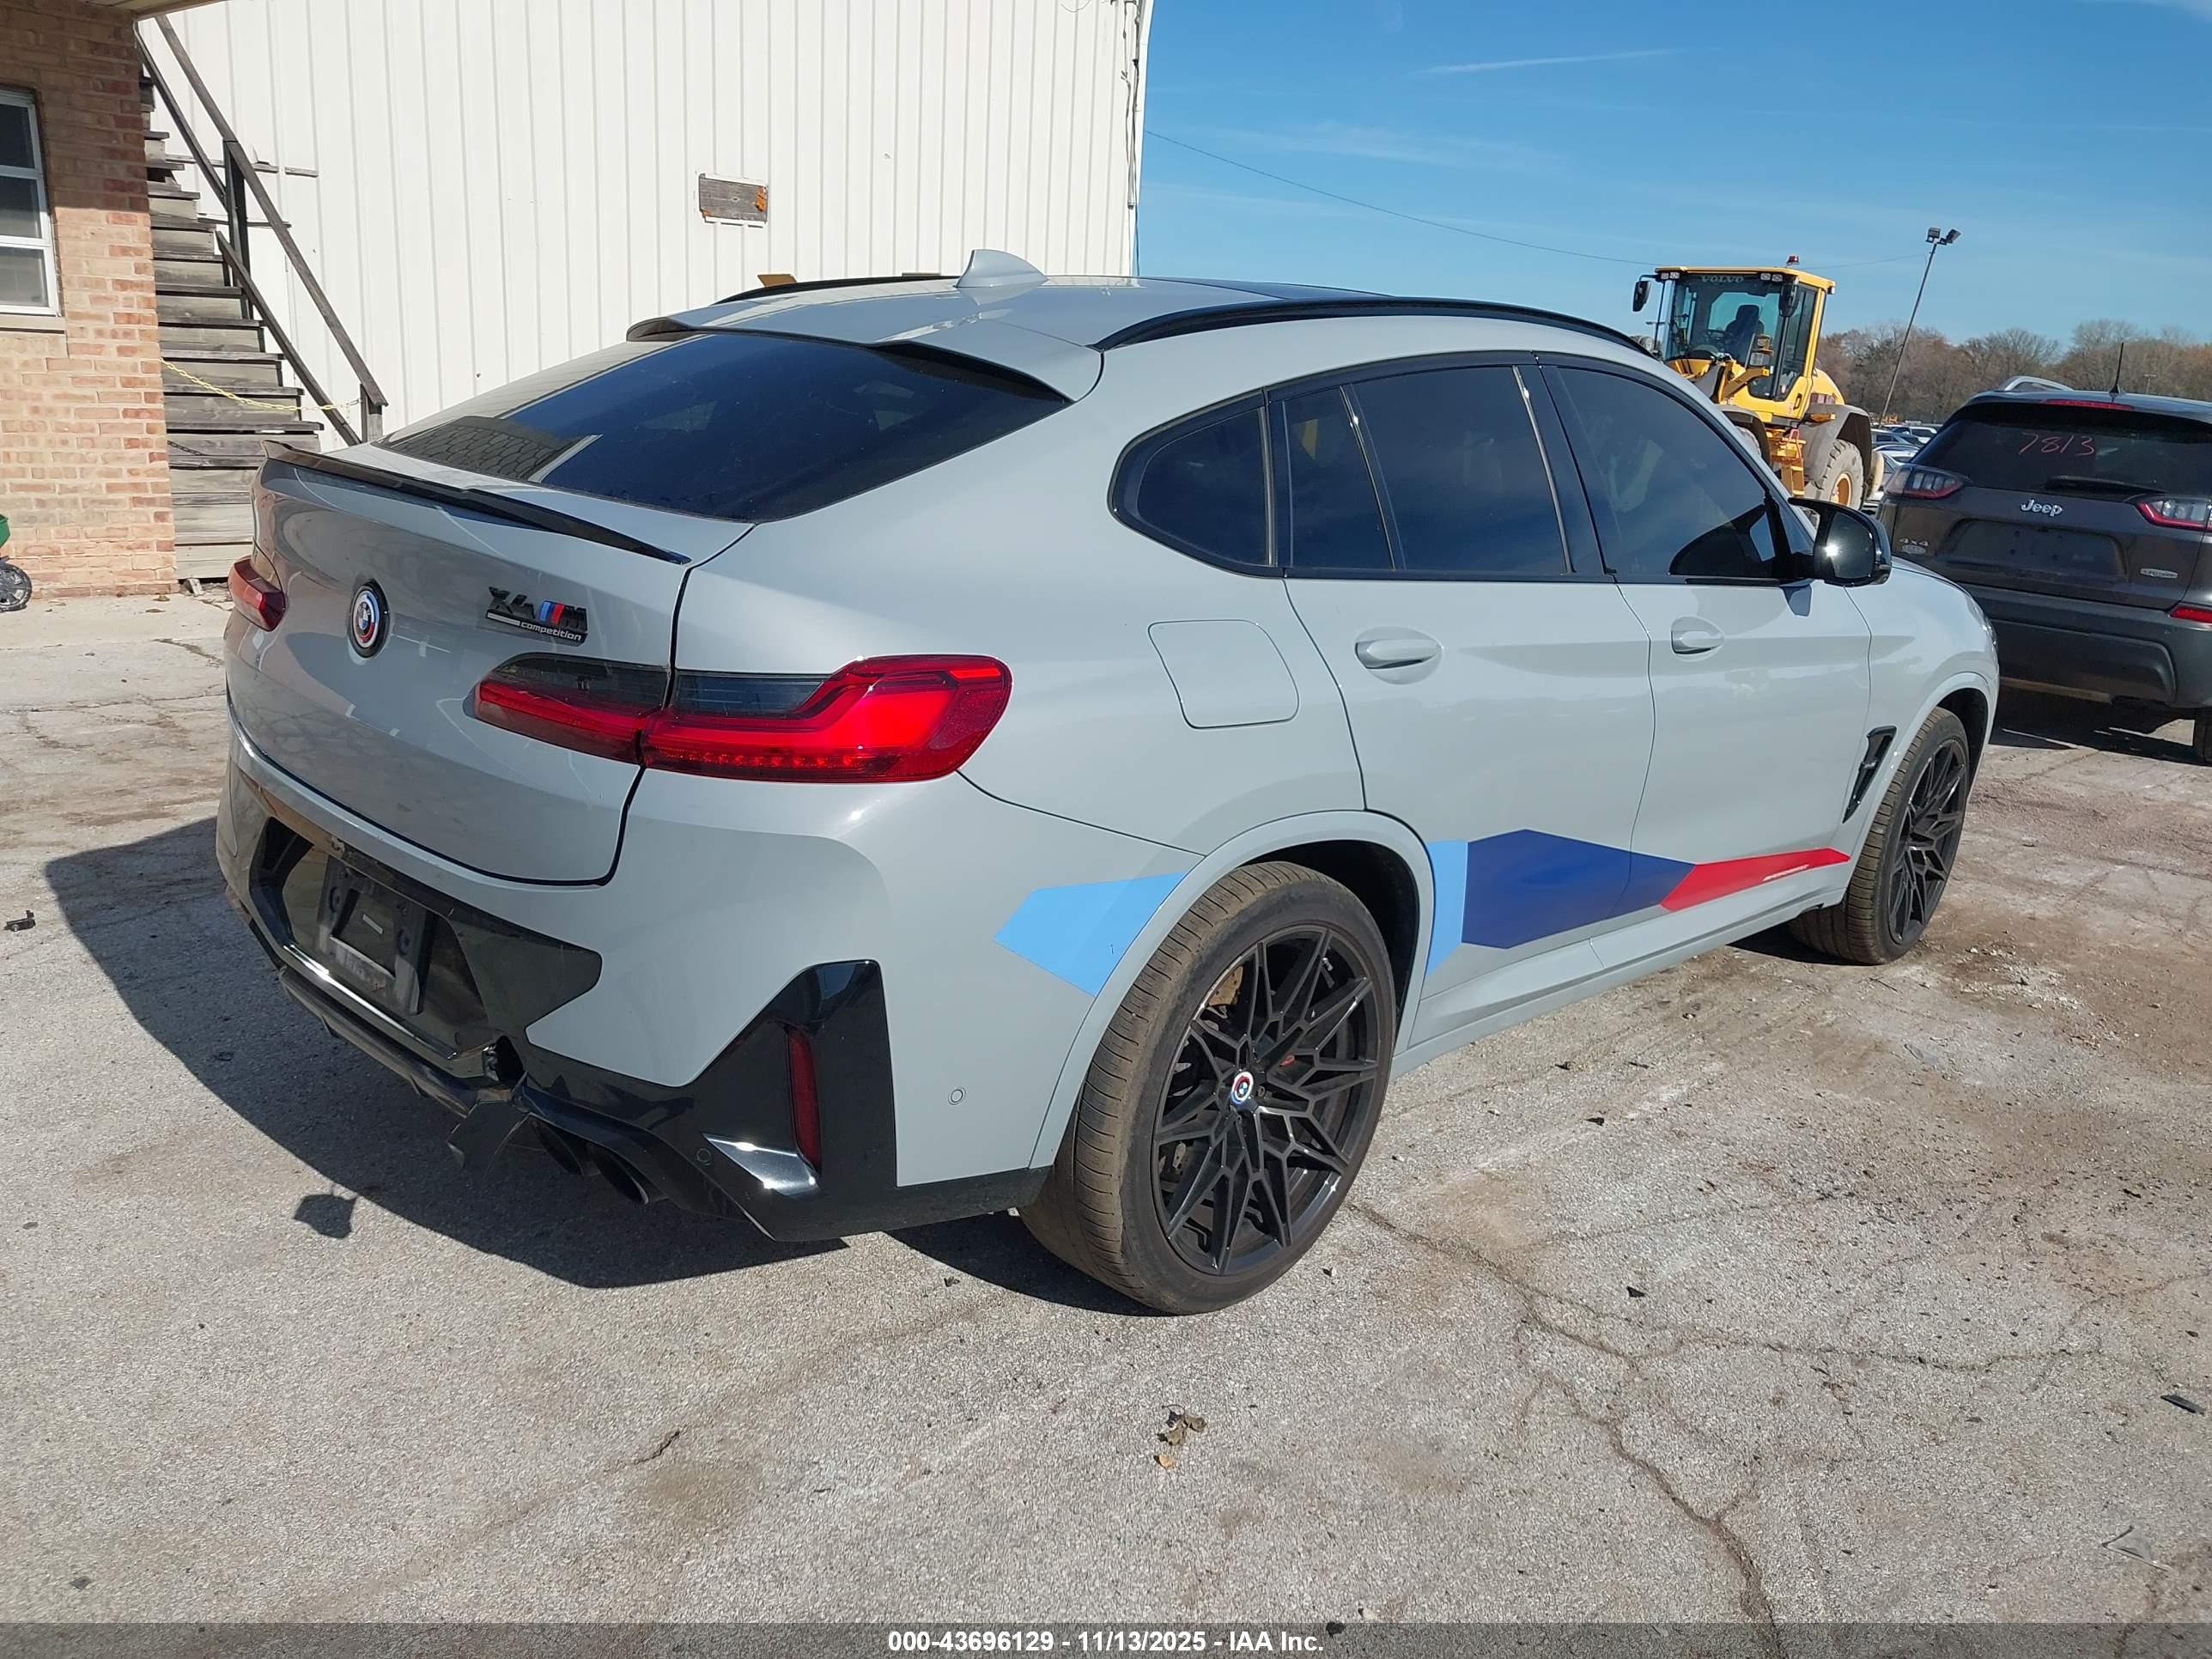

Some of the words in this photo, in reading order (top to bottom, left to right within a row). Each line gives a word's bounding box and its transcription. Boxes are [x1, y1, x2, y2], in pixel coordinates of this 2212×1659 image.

[2018, 432, 2095, 456] 7813
[2021, 498, 2063, 517] Jeep
[521, 622, 583, 641] competition
